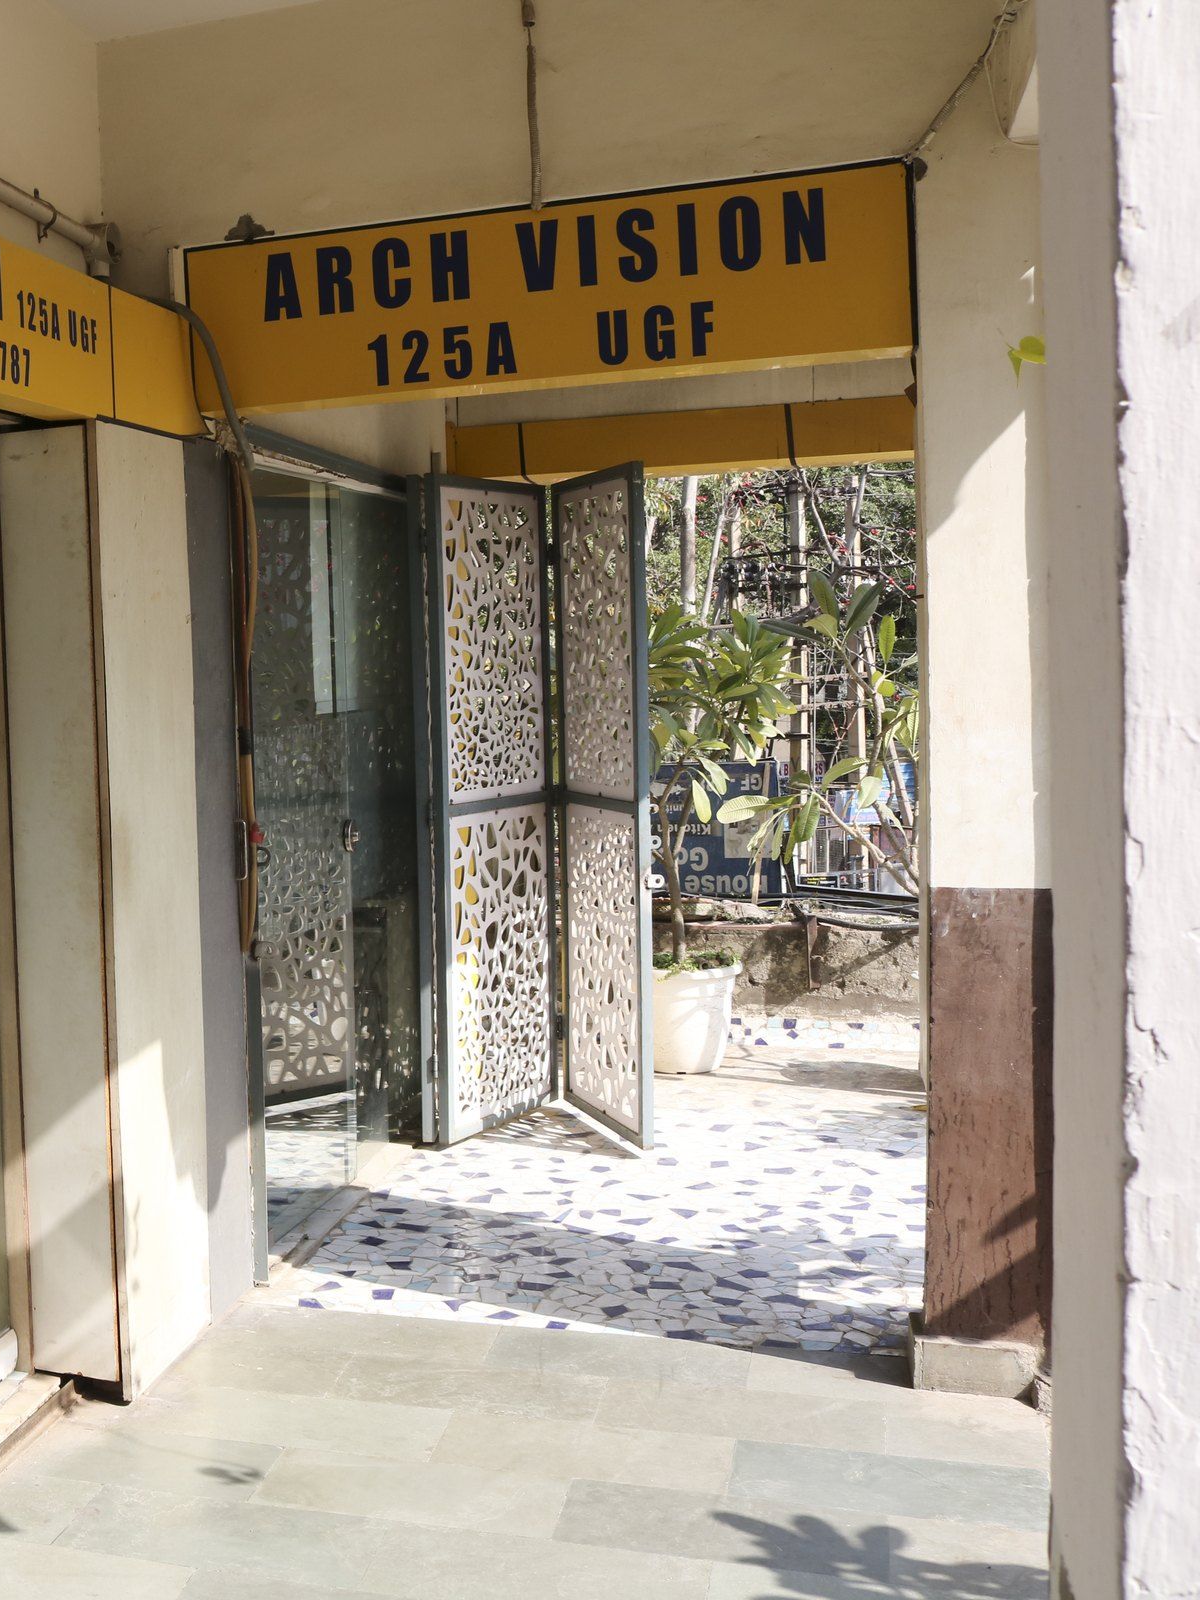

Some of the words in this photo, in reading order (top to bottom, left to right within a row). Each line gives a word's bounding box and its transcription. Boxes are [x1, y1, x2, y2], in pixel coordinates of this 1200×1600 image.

[263, 230, 470, 322] ARCH
[515, 187, 828, 293] VISION
[15, 289, 61, 341] 125A
[67, 306, 99, 355] UGF
[366, 321, 519, 387] 125A
[595, 300, 715, 366] UGF
